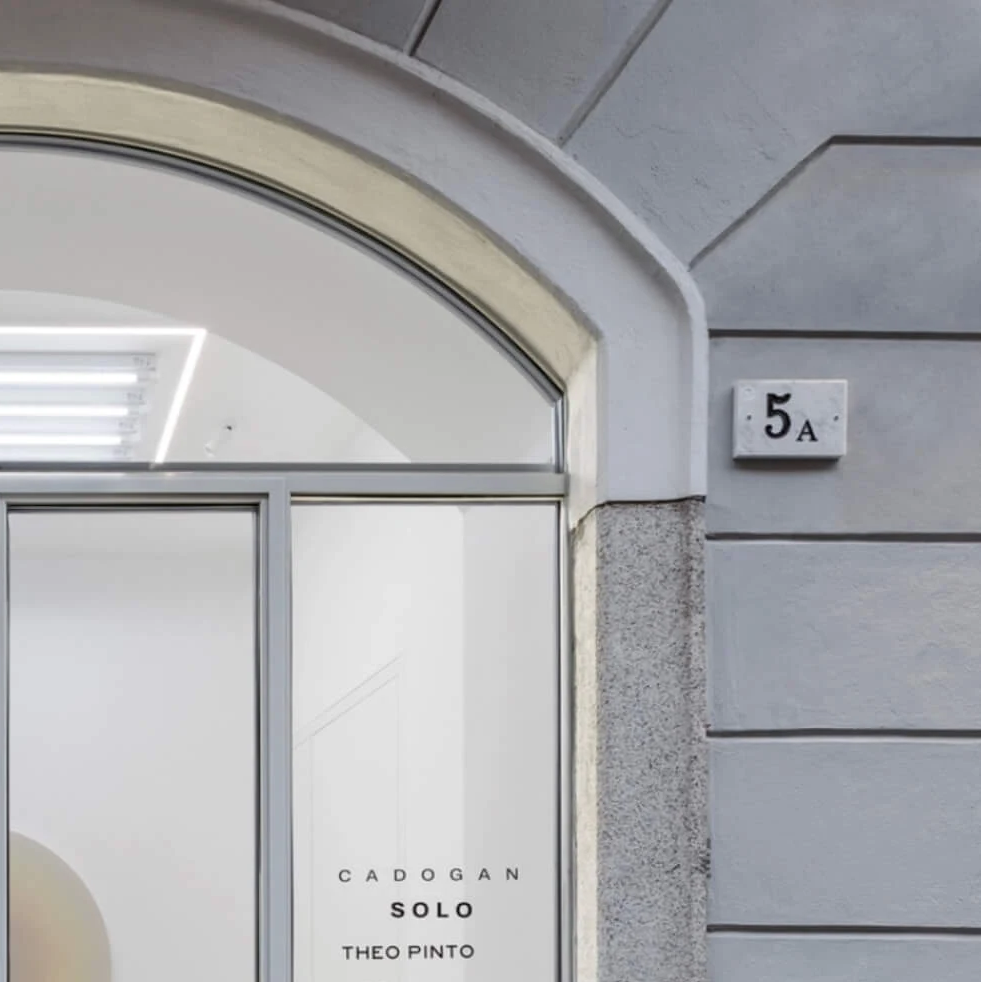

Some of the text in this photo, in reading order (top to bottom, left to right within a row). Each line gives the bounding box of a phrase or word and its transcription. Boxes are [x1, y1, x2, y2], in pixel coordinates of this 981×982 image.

[765, 393, 818, 442] 5A
[338, 867, 519, 883] CADOGAN
[391, 901, 473, 918] SOLO
[342, 944, 475, 960] THEO PINTO
